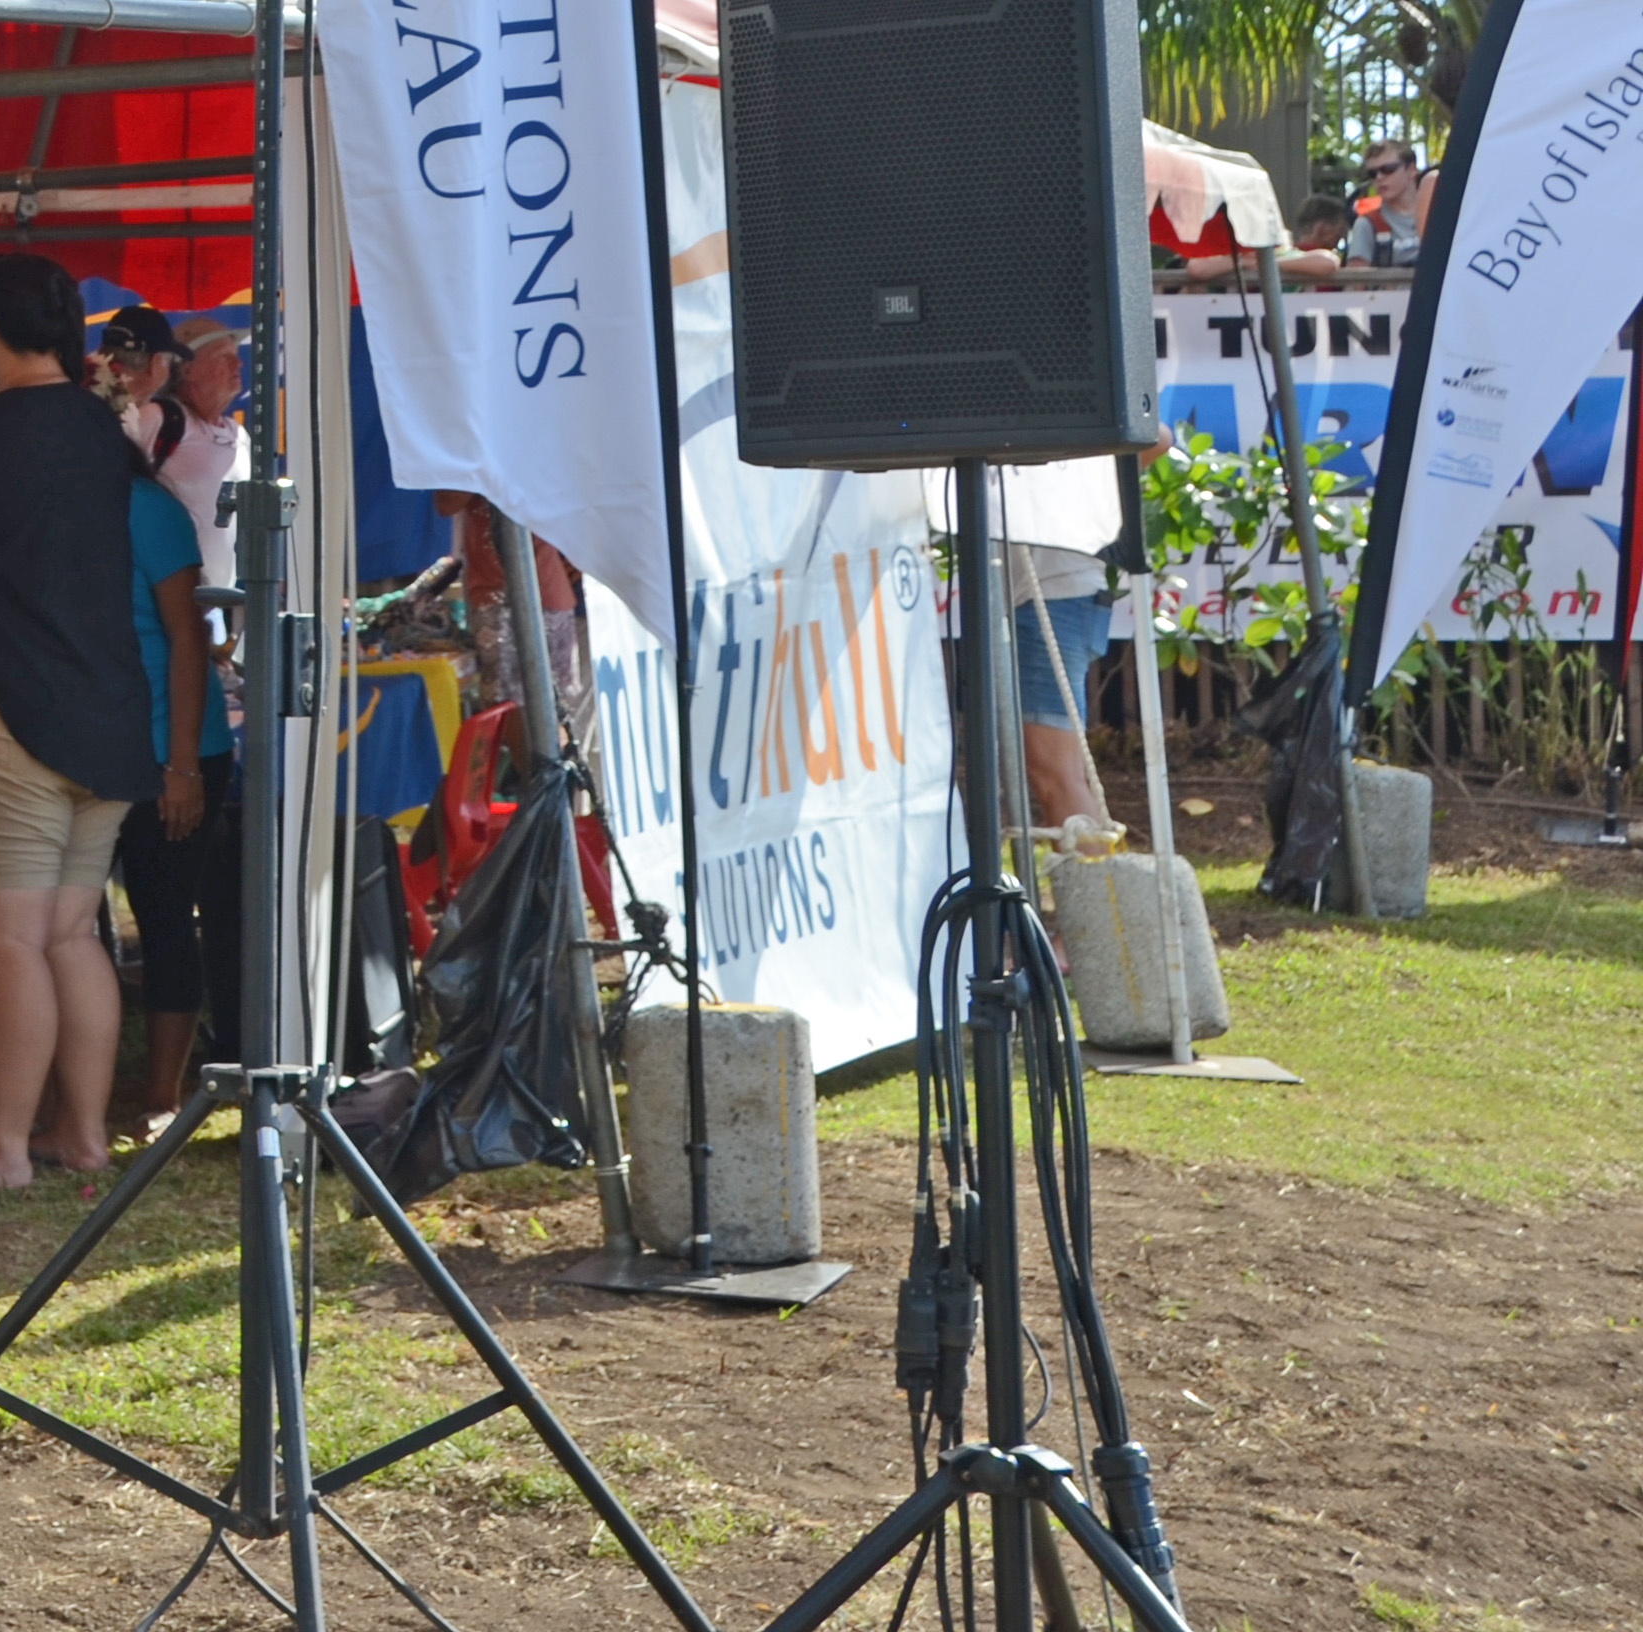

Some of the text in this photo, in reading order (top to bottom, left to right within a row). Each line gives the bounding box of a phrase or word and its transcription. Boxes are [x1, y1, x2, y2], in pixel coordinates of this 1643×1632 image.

[1561, 48, 1643, 153] Islan
[1542, 142, 1589, 204] of
[1467, 201, 1562, 292] Bay
[884, 295, 915, 314] JBL
[1207, 313, 1405, 358] TUN
